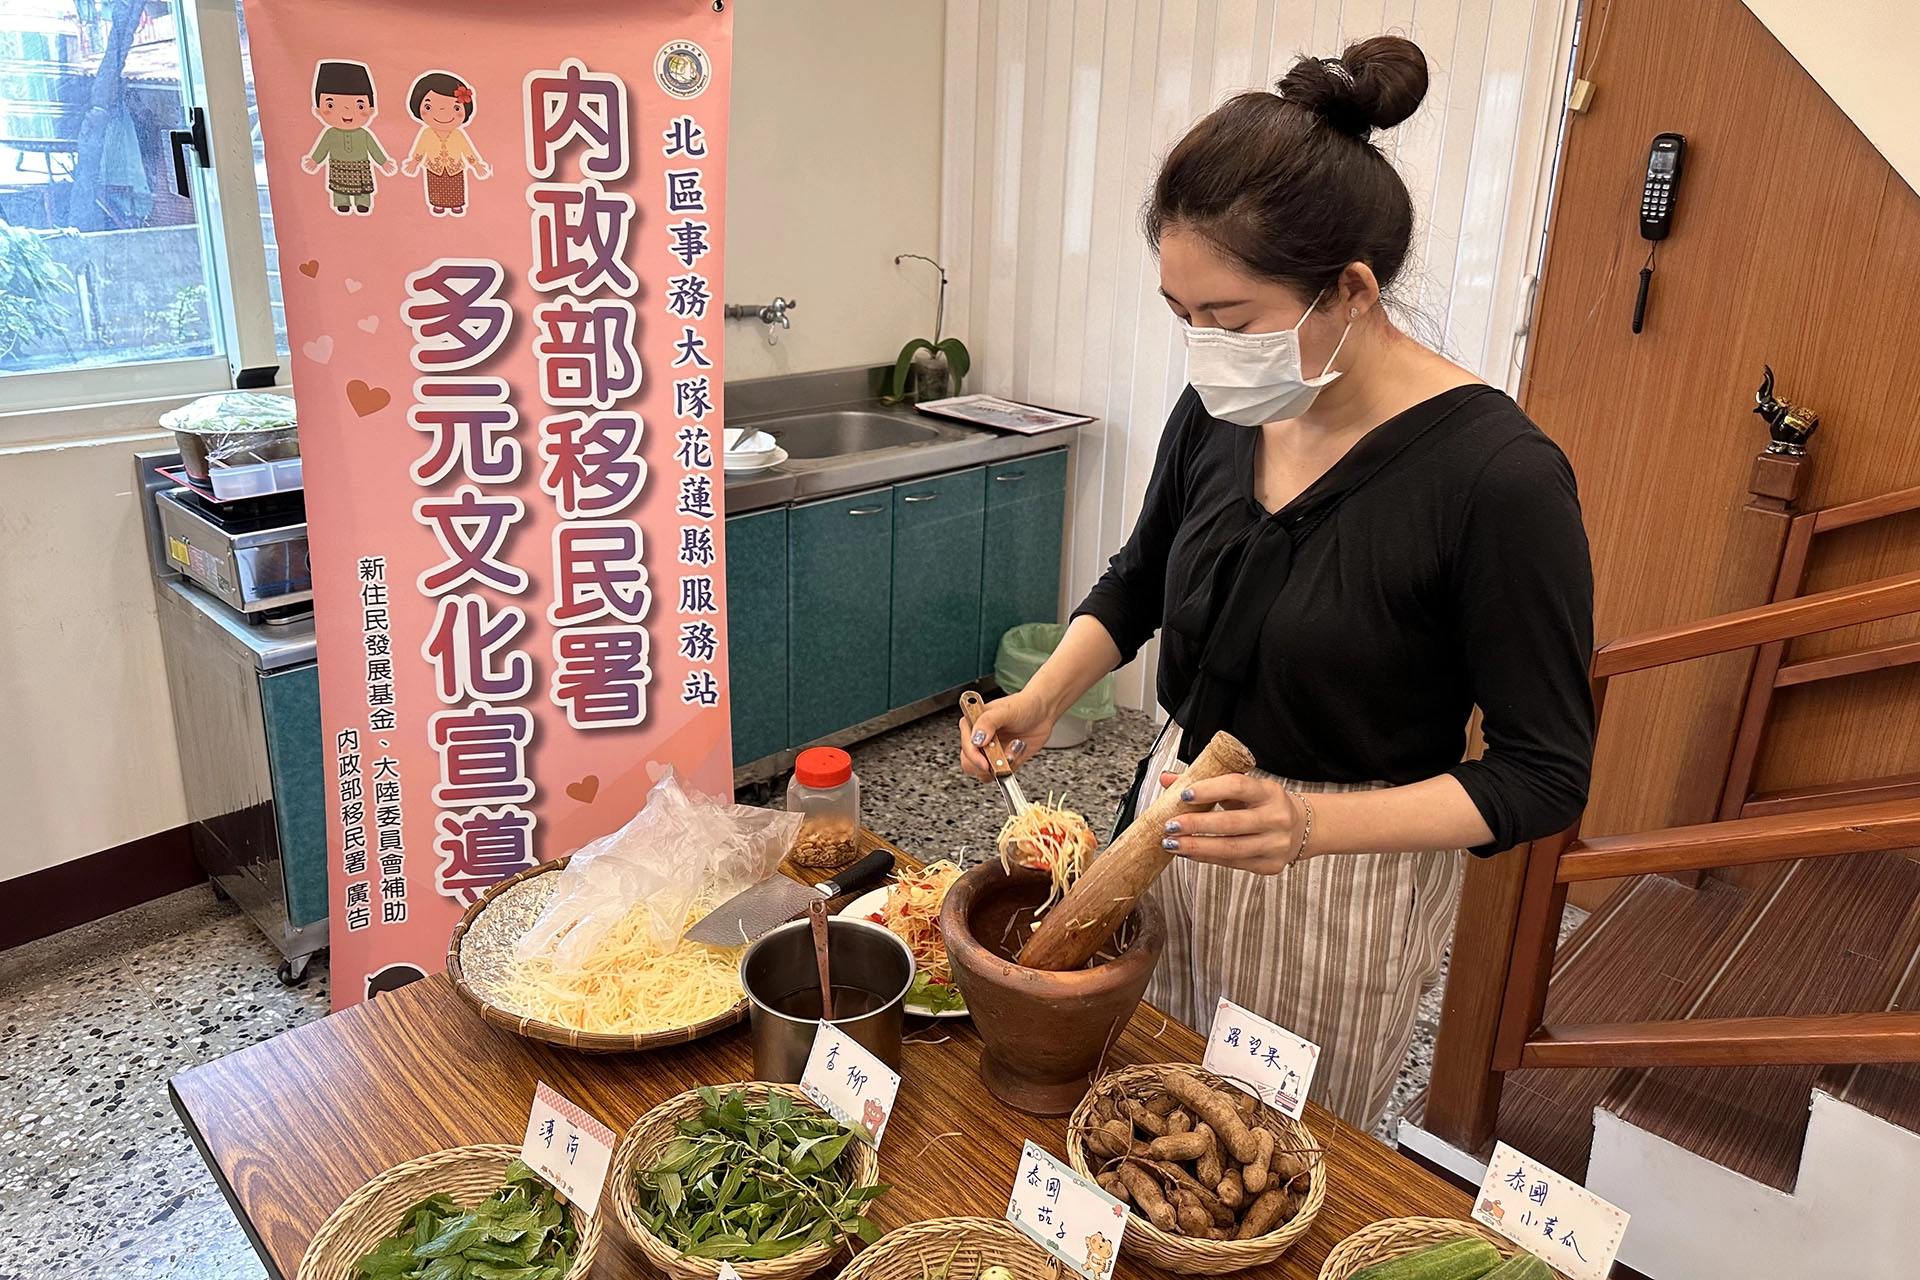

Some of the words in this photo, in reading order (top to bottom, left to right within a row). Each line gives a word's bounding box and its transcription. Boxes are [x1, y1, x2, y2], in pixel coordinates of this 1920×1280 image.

[664, 117, 719, 707] 北區事務大隊花蓮縣服務站
[406, 262, 533, 903] 多元文化宣導
[359, 556, 408, 923] 新住民發展基金、大陸委員會補助
[345, 882, 371, 931] 廣告
[1026, 1163, 1061, 1205] 泰國
[1503, 1167, 1550, 1207] 泰國
